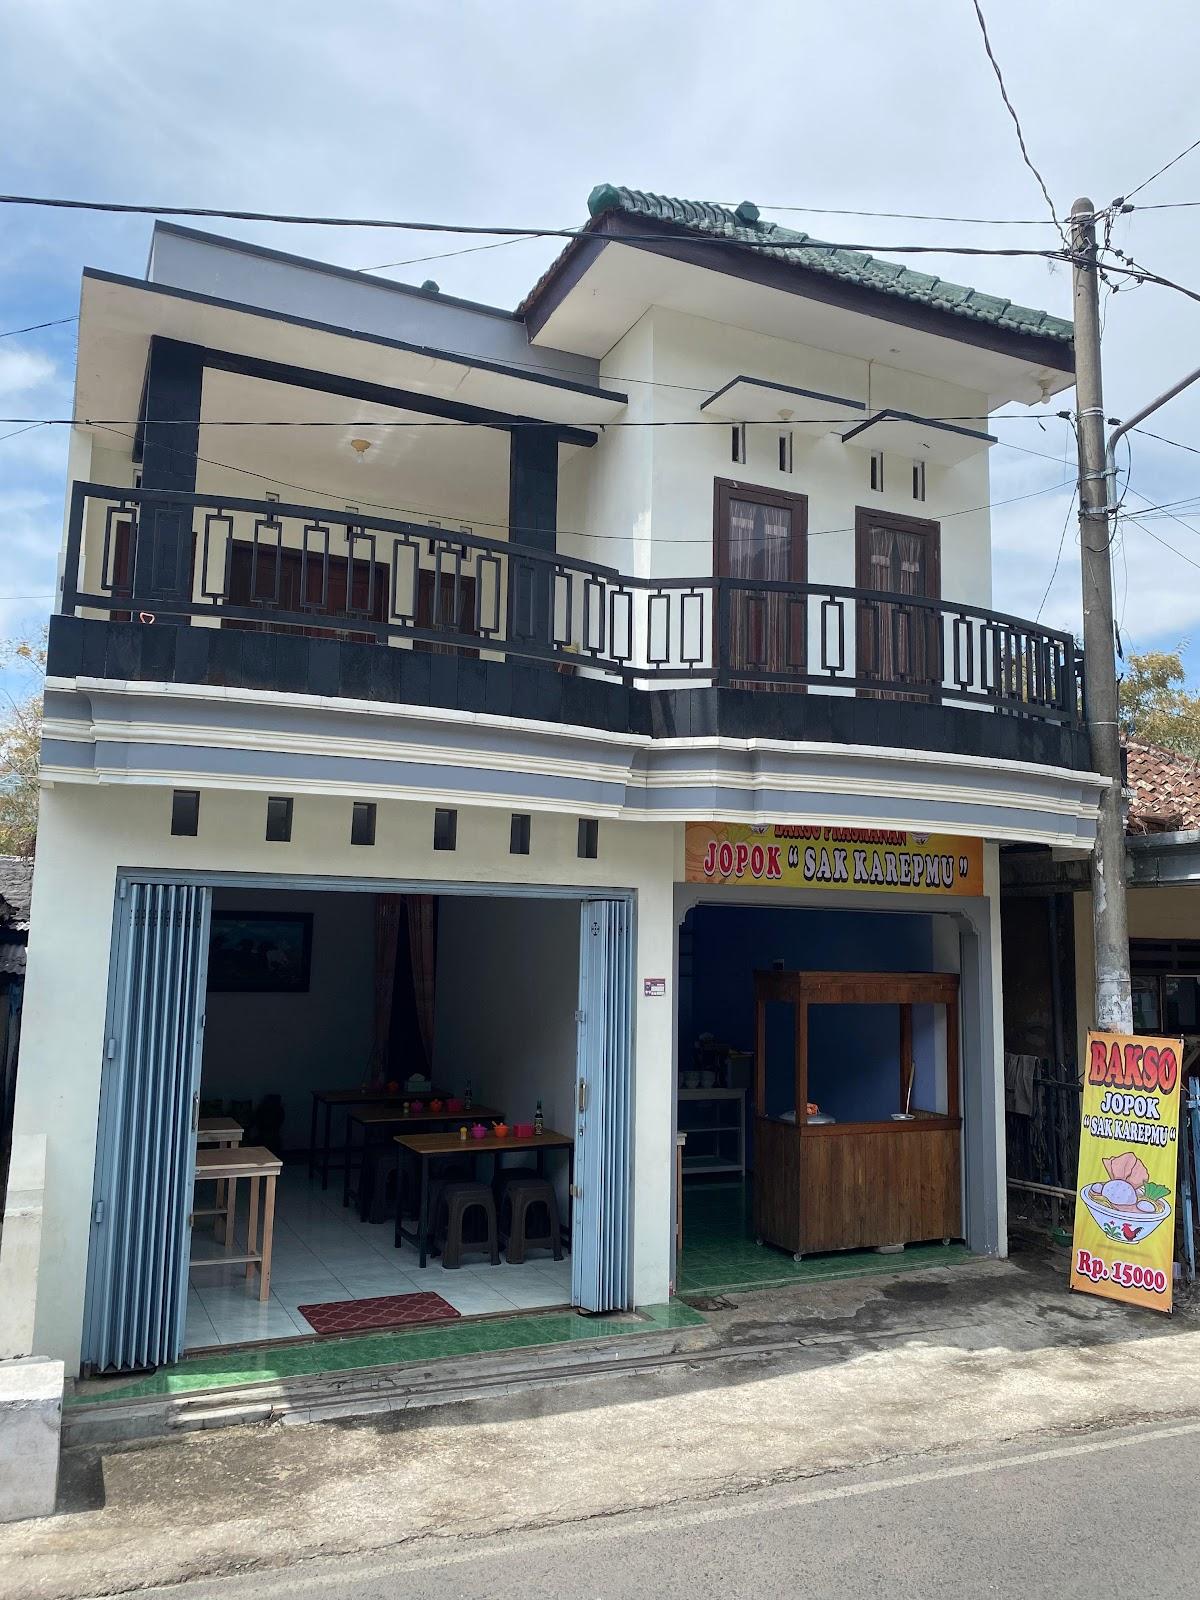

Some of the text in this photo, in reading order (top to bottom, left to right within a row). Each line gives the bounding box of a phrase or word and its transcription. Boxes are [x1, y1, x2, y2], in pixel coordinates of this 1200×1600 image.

[703, 841, 782, 879] JOPOK
[803, 847, 848, 881] SAK
[853, 850, 954, 887] KAREPMU
[1089, 1041, 1177, 1095] BAKSO
[1101, 1091, 1160, 1120] JOPOK
[1114, 1118, 1168, 1147] KAREPMU
[1077, 1249, 1167, 1293] Rp. 15000
